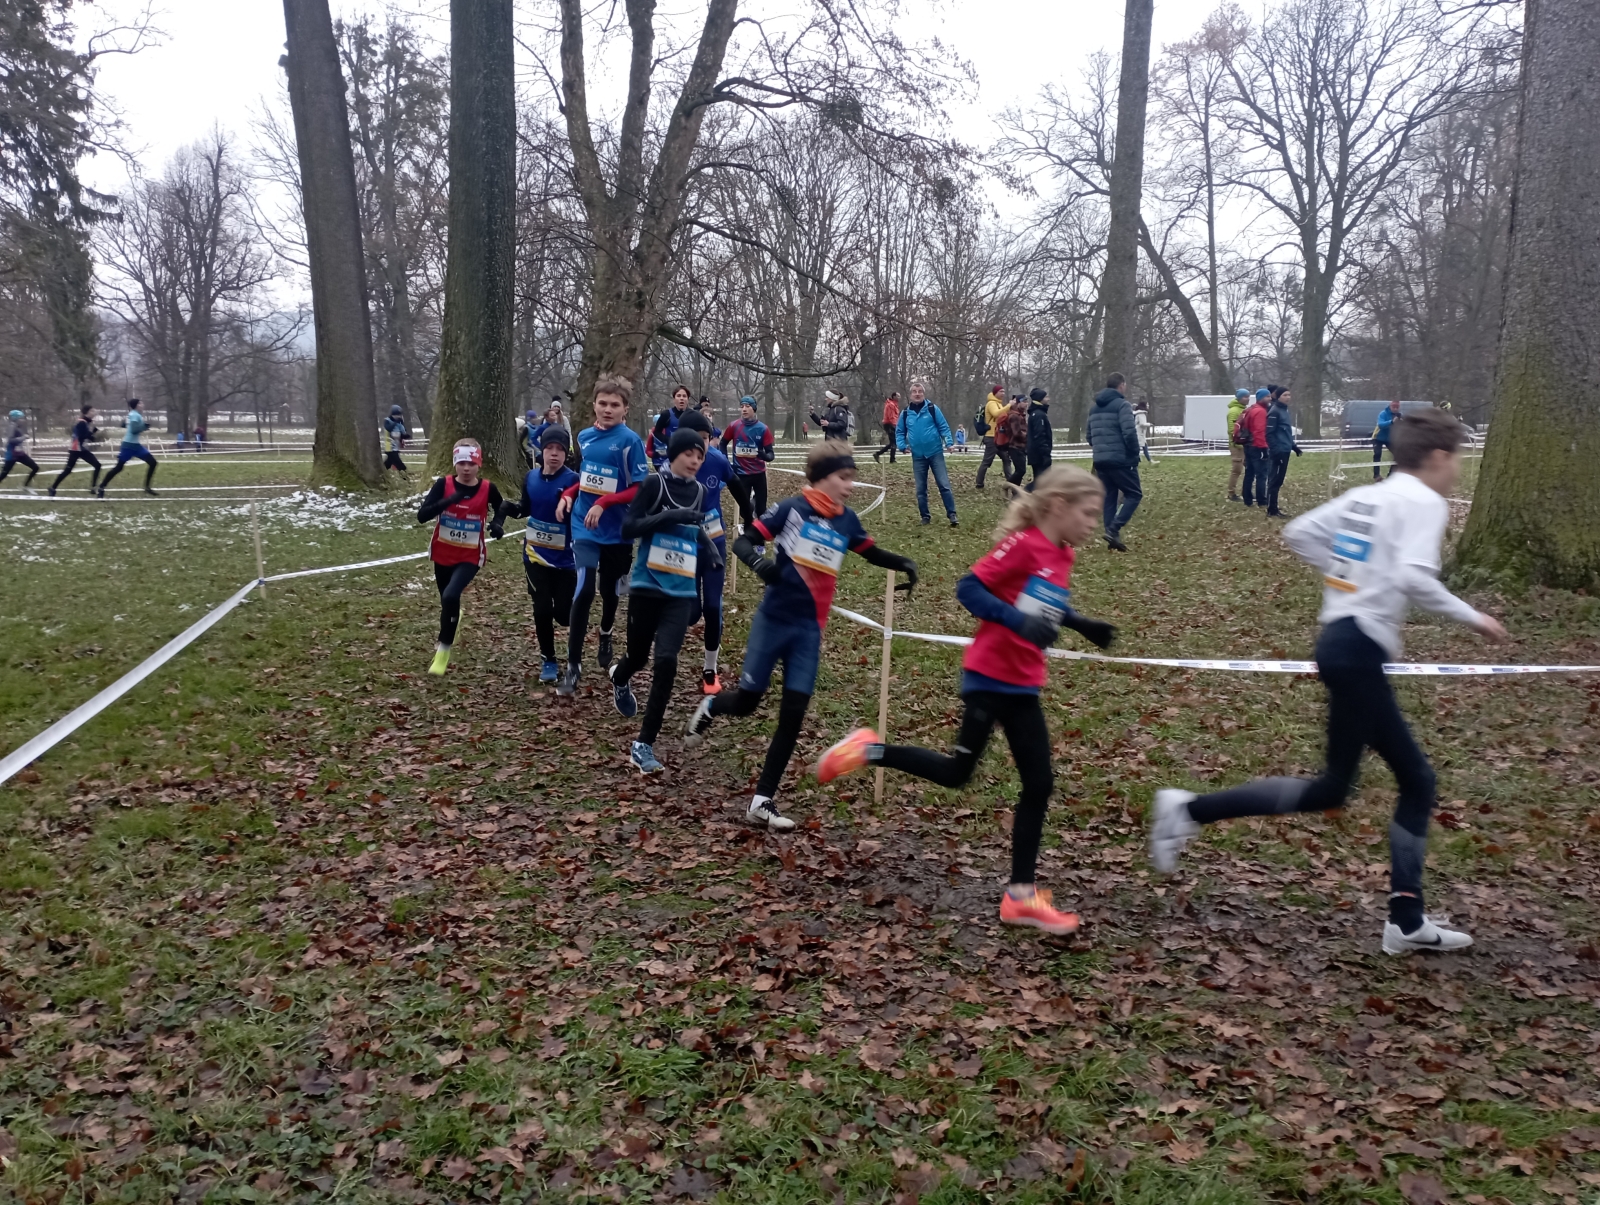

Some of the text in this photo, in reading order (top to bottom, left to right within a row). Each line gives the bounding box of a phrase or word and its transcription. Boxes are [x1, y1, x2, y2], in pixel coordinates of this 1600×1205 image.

[586, 474, 604, 486] 665
[449, 530, 468, 540] 645
[535, 531, 553, 542] 675
[664, 549, 686, 565] 676
